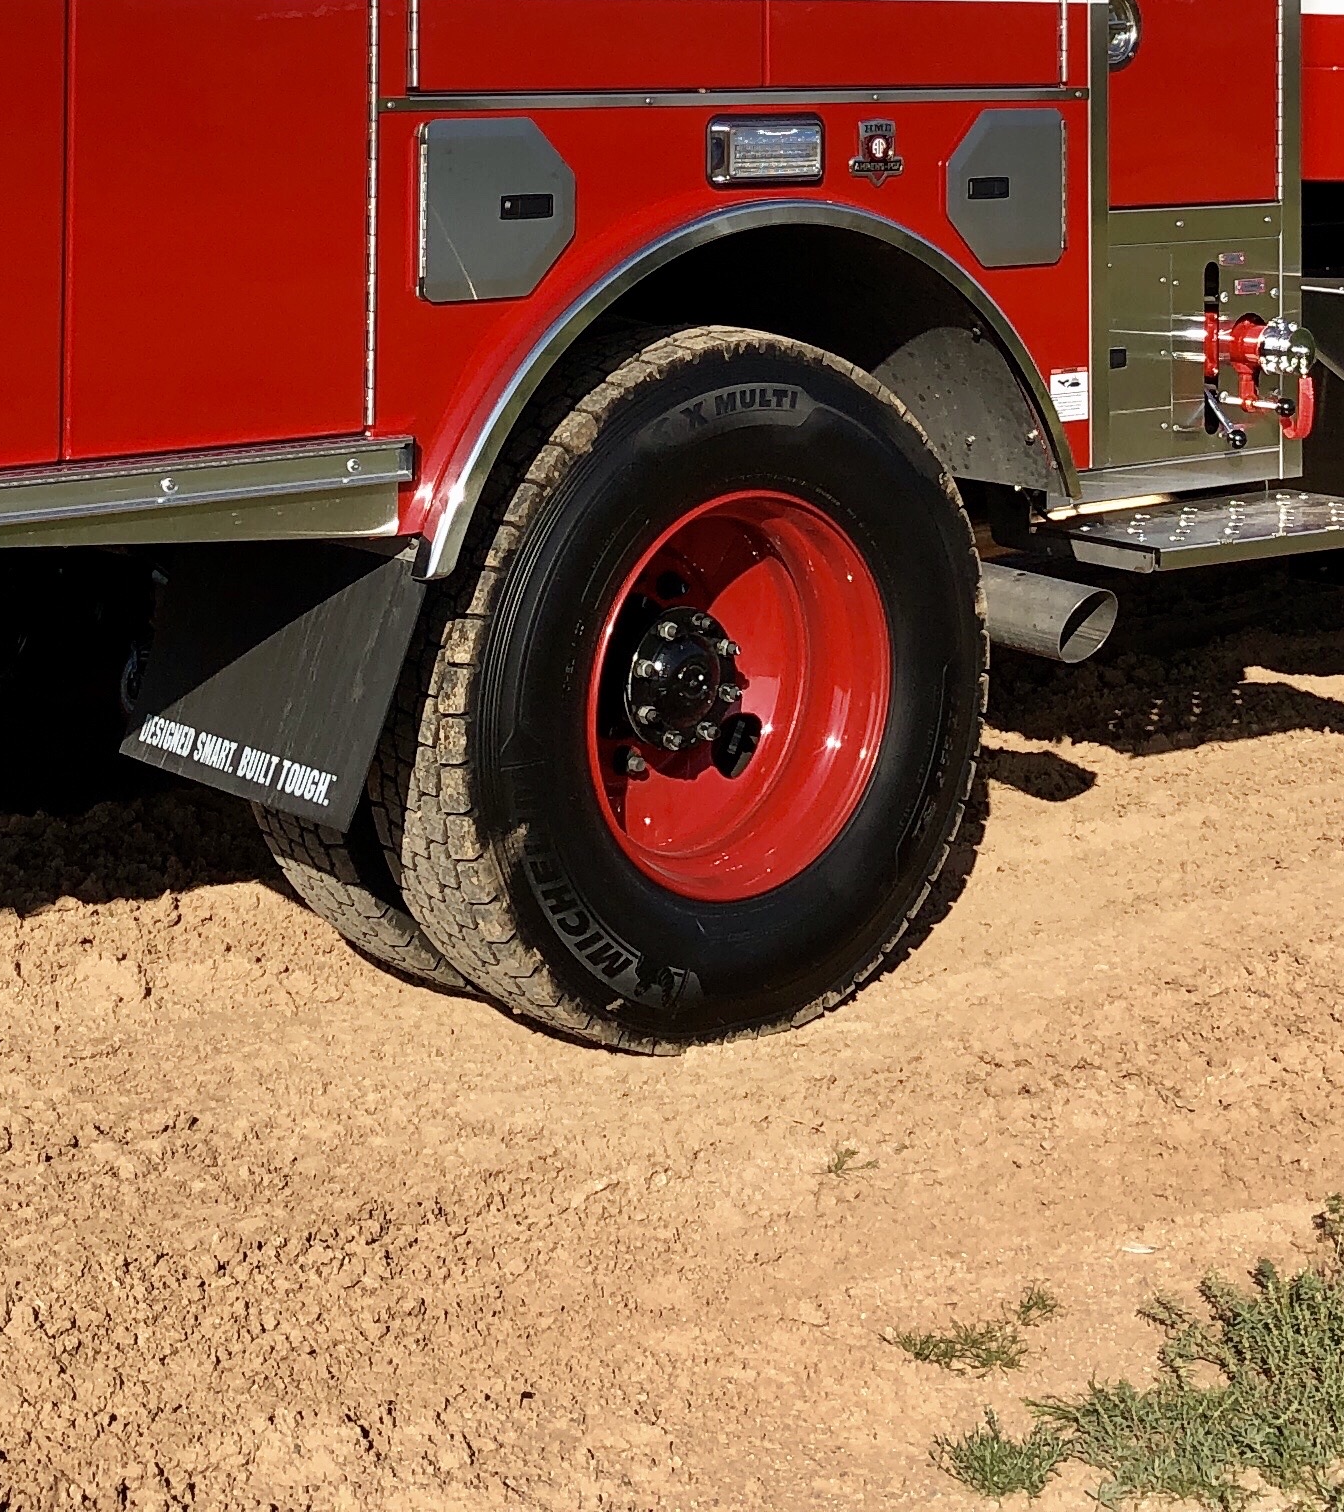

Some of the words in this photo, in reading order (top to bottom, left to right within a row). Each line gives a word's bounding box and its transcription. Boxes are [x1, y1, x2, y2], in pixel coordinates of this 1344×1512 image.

[679, 399, 708, 429] X
[714, 388, 799, 416] MULTI
[138, 713, 196, 758] DESIGNED
[193, 731, 238, 774] SMART.
[236, 745, 281, 787] BUILT
